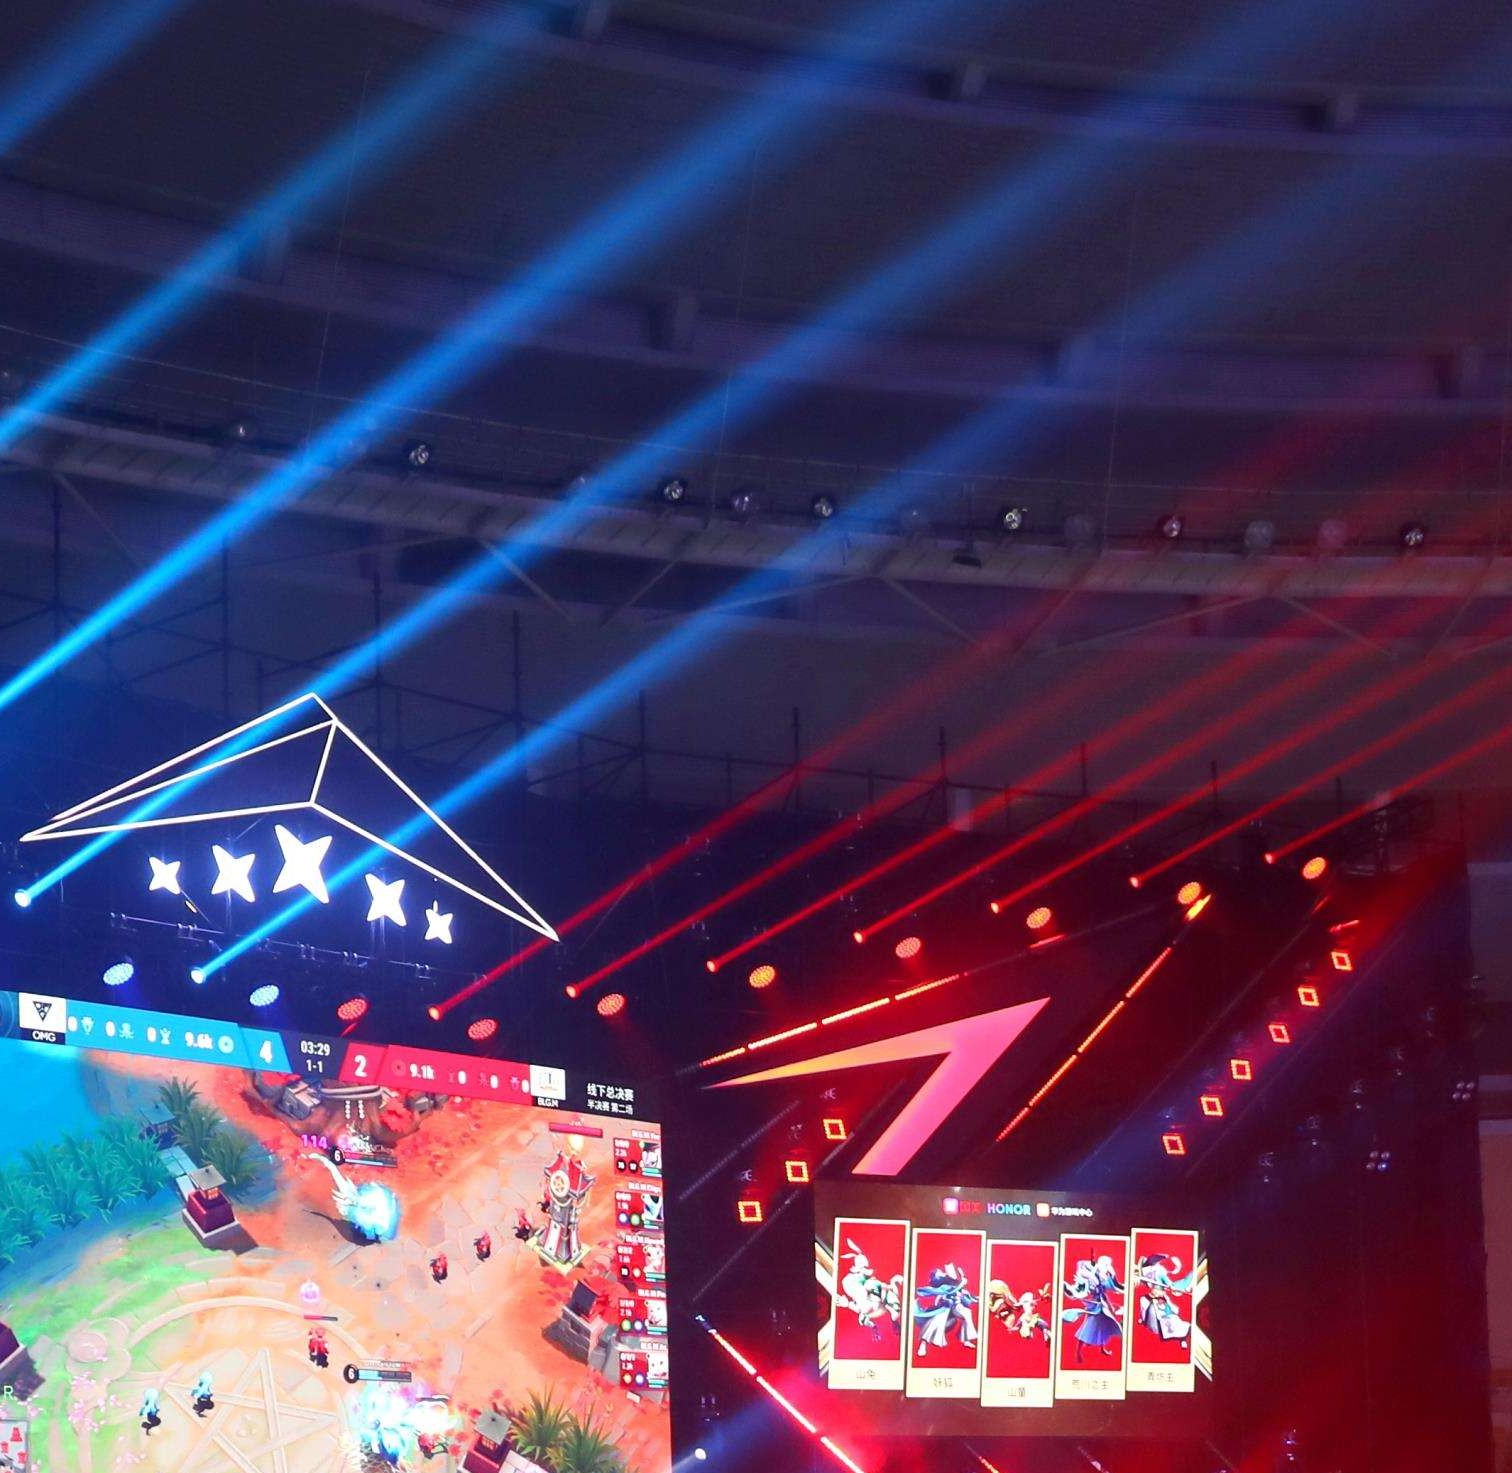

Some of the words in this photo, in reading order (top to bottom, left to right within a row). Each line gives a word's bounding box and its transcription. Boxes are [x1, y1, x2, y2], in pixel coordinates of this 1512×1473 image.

[67, 1016, 78, 1032] 0
[105, 1020, 116, 1037] 0
[32, 1031, 56, 1042] OMG
[259, 1040, 273, 1063] 4
[300, 1040, 331, 1056] 03:29
[306, 1059, 324, 1073] 1-1
[354, 1054, 368, 1077] 2
[409, 1063, 435, 1080] 9.1k
[457, 1070, 467, 1085] 0
[490, 1074, 499, 1089] 0
[587, 1083, 634, 1101] 线下总决赛
[301, 1134, 328, 1149] 114
[334, 1149, 341, 1161] 6
[987, 1203, 1031, 1216] HONOR
[348, 1368, 355, 1380] 6
